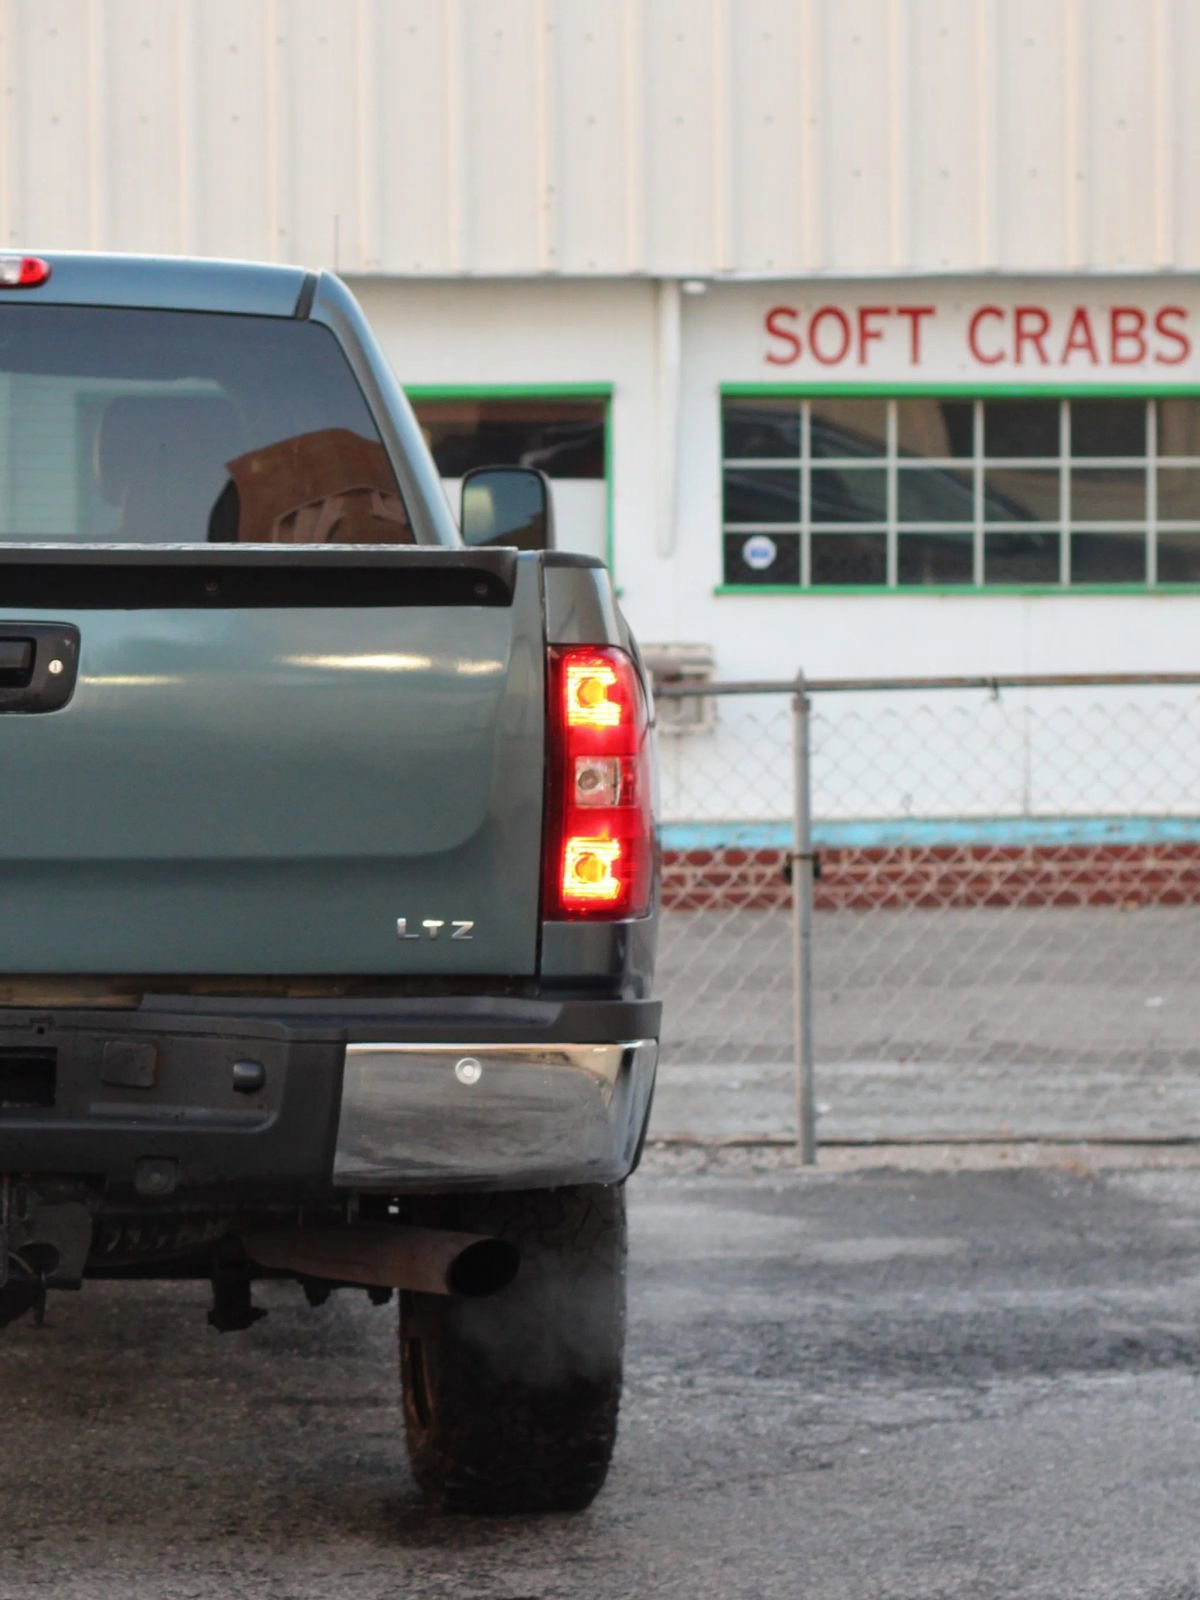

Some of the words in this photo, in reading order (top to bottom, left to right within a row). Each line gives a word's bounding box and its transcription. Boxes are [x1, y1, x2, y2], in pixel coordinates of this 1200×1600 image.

[764, 305, 936, 367] SOFT
[967, 304, 1193, 367] CRABS
[396, 917, 475, 940] LTZ
